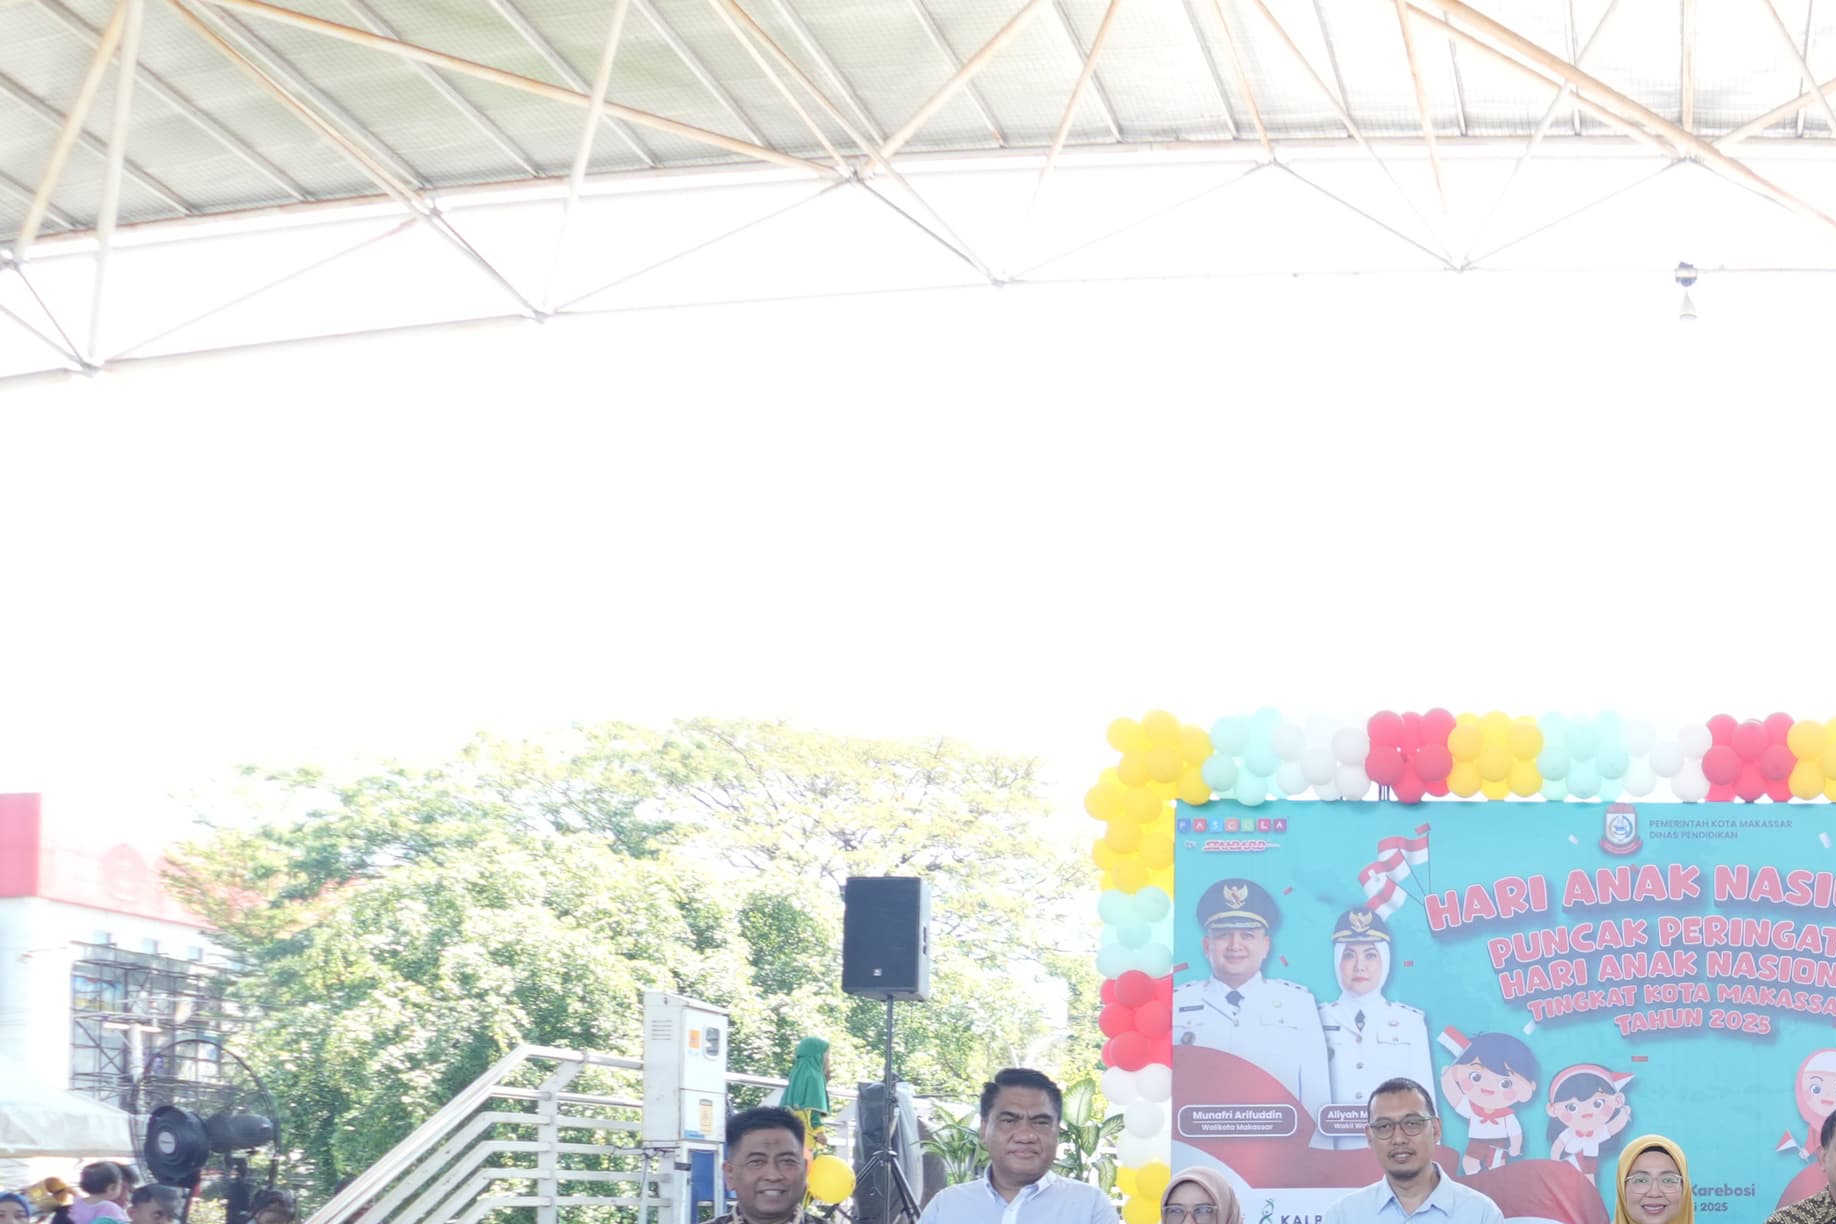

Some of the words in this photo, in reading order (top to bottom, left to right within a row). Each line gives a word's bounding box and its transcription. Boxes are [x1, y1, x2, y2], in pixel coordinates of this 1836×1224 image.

[1649, 819, 1708, 828] PEMERINTAH
[1711, 819, 1737, 828] KOTA
[1739, 819, 1792, 829] MAKASSAR
[1649, 831, 1679, 840] DINAS
[1681, 831, 1738, 840] PENDIDIKAN
[1425, 874, 1548, 931] HARI
[1562, 863, 1701, 907] ANAK
[1487, 918, 1648, 969] PUNCAK
[1499, 959, 1588, 1000] HARI
[1598, 950, 1698, 981] ANAK
[1527, 984, 1637, 1022] TINGKAT
[1644, 982, 1710, 1004] KOTA
[1614, 1007, 1703, 1036] TAHUN
[1709, 1008, 1771, 1035] 2025
[1193, 1110, 1232, 1120] Munafri
[1234, 1110, 1283, 1120] Arifuddin
[1327, 1110, 1359, 1121] Aliyah
[1201, 1123, 1235, 1131] Walikota
[1236, 1123, 1273, 1131] Makassar
[1700, 1202, 1729, 1212] 2025
